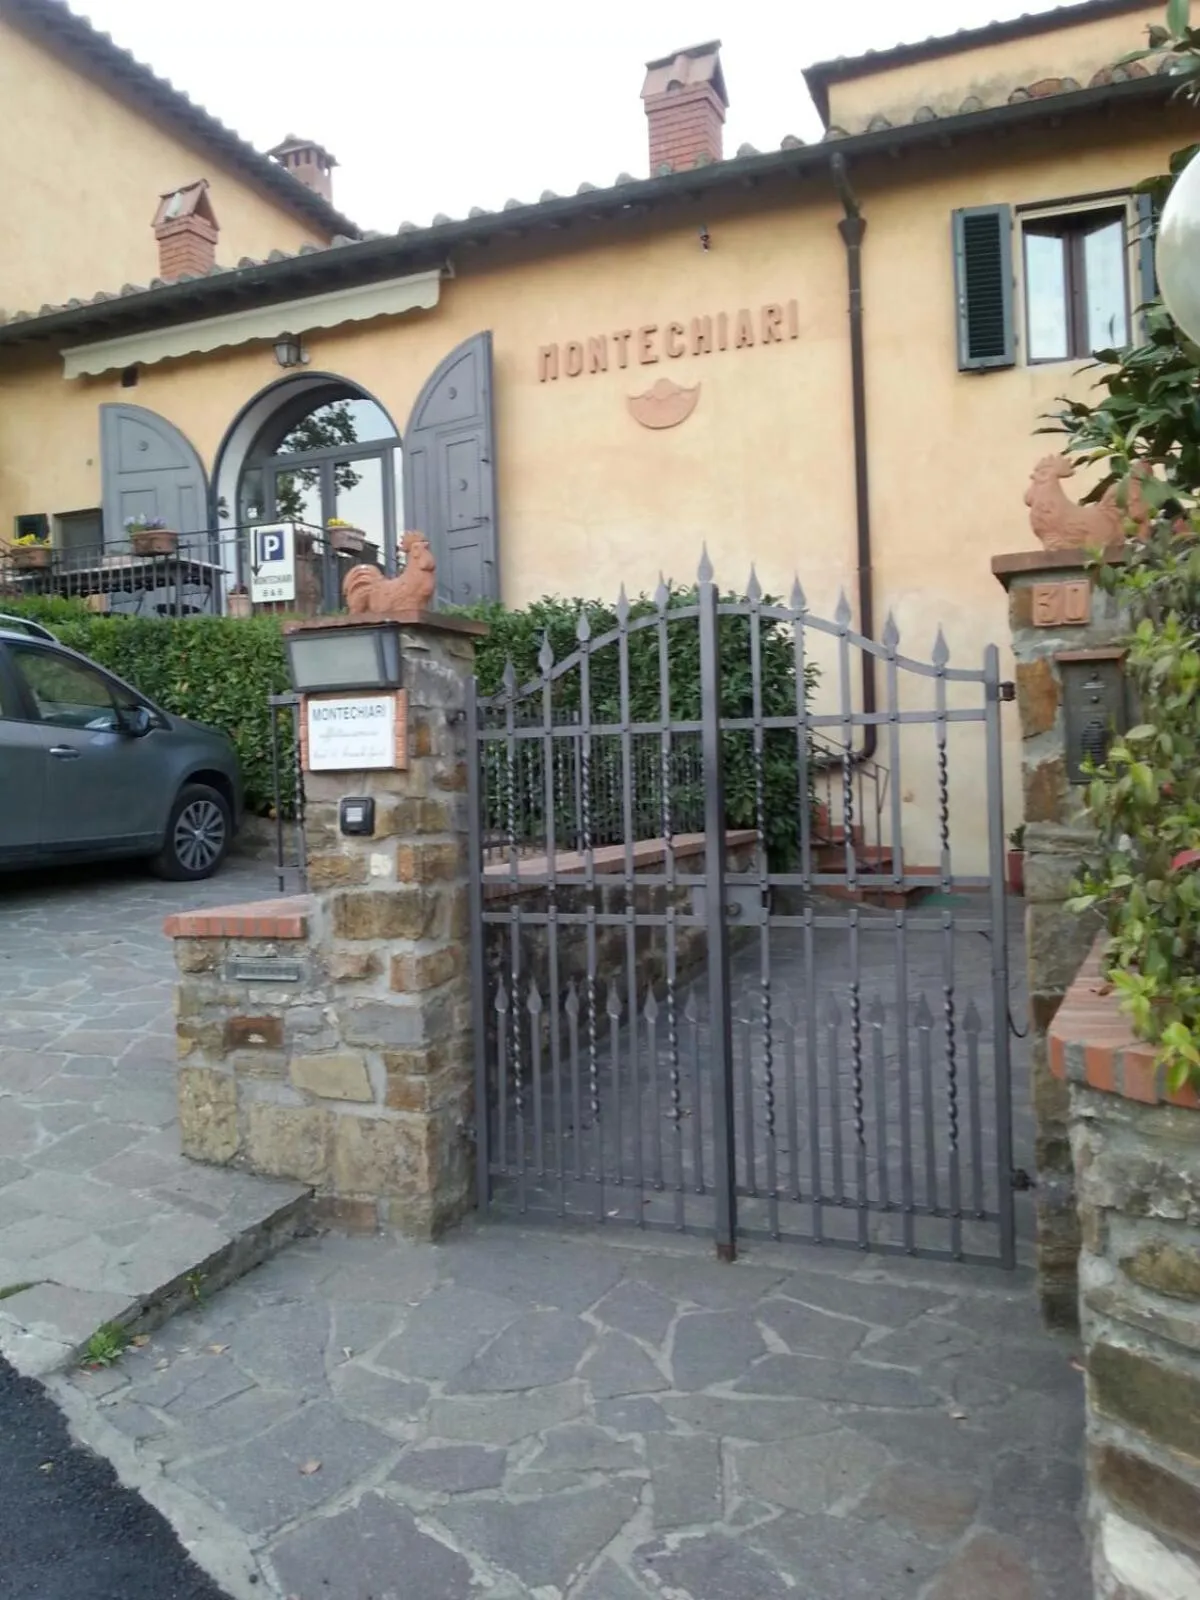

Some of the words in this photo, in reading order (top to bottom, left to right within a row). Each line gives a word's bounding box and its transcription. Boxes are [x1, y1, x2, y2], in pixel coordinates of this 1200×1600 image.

[537, 299, 800, 383] MONTECHIARI
[263, 535, 280, 560] P
[312, 703, 387, 721] MONTECHIARI
